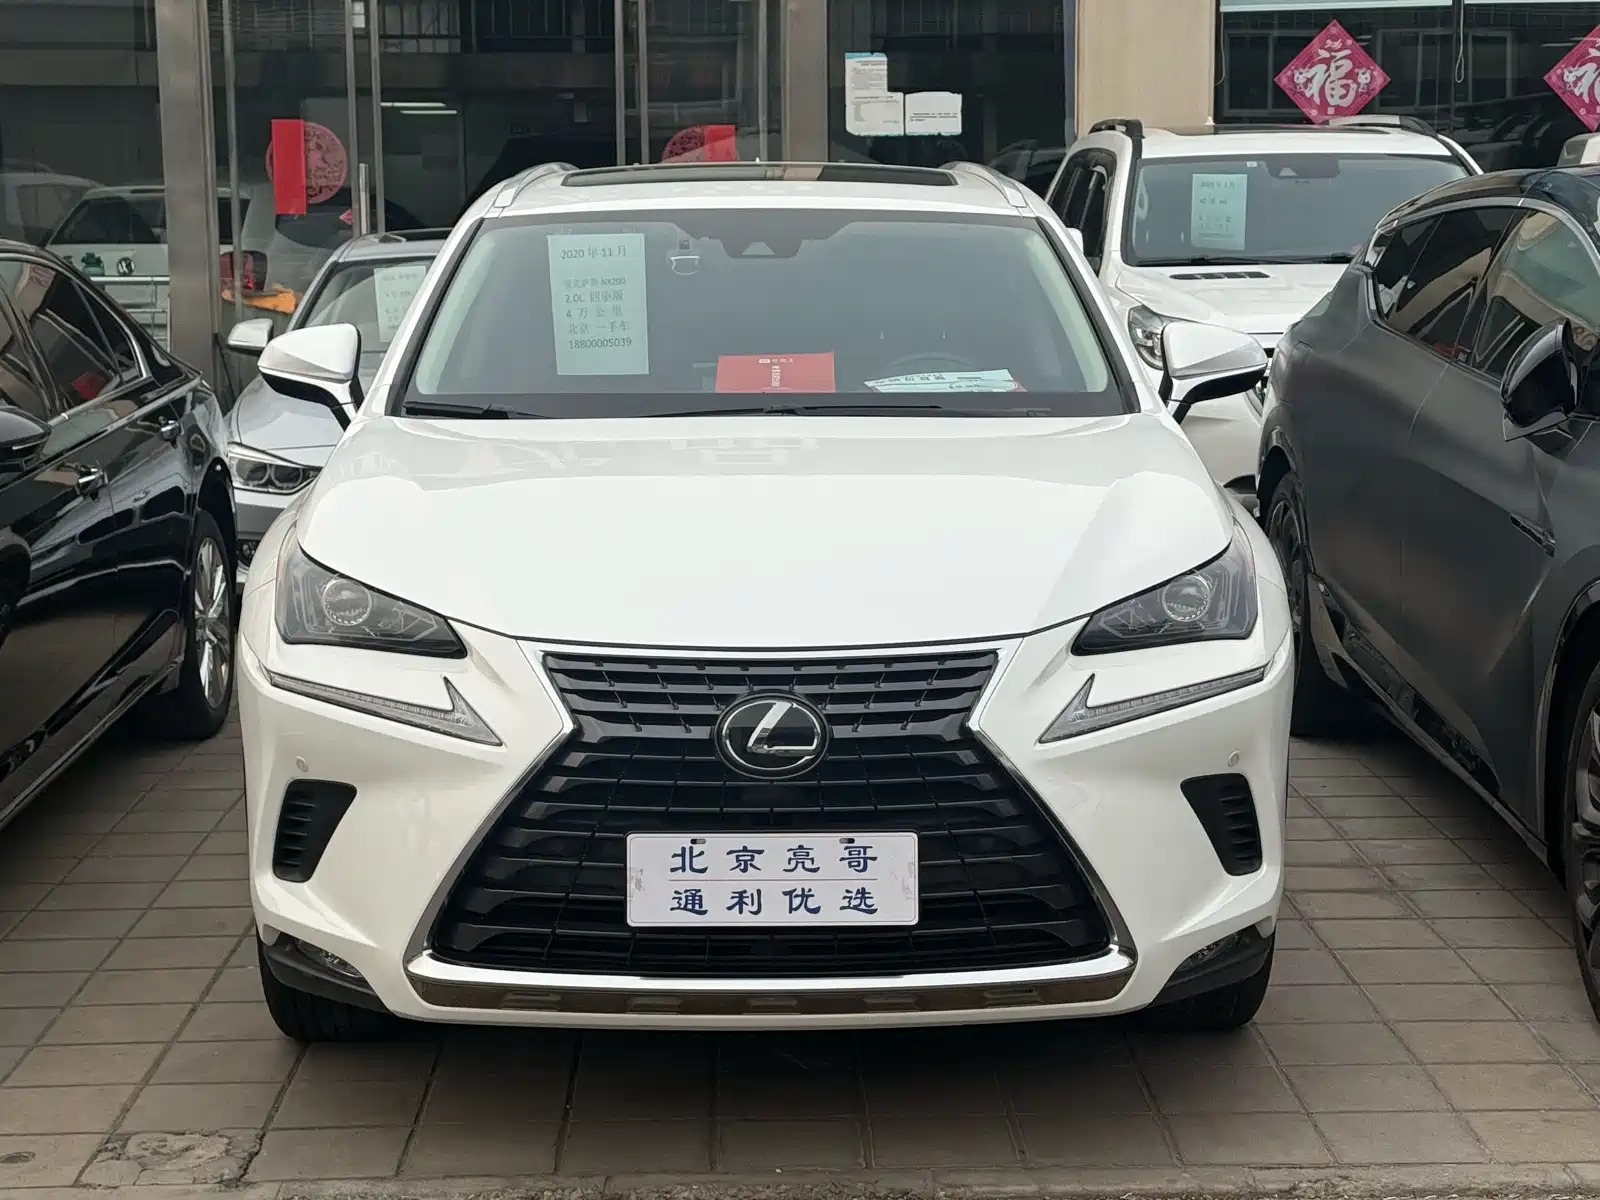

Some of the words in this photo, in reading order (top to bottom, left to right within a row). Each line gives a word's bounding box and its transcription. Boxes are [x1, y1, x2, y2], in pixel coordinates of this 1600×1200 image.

[1304, 48, 1358, 108] 福
[568, 337, 632, 349] 18800005039
[669, 844, 878, 874] 北京亮哥
[669, 887, 878, 916] 通利优选
